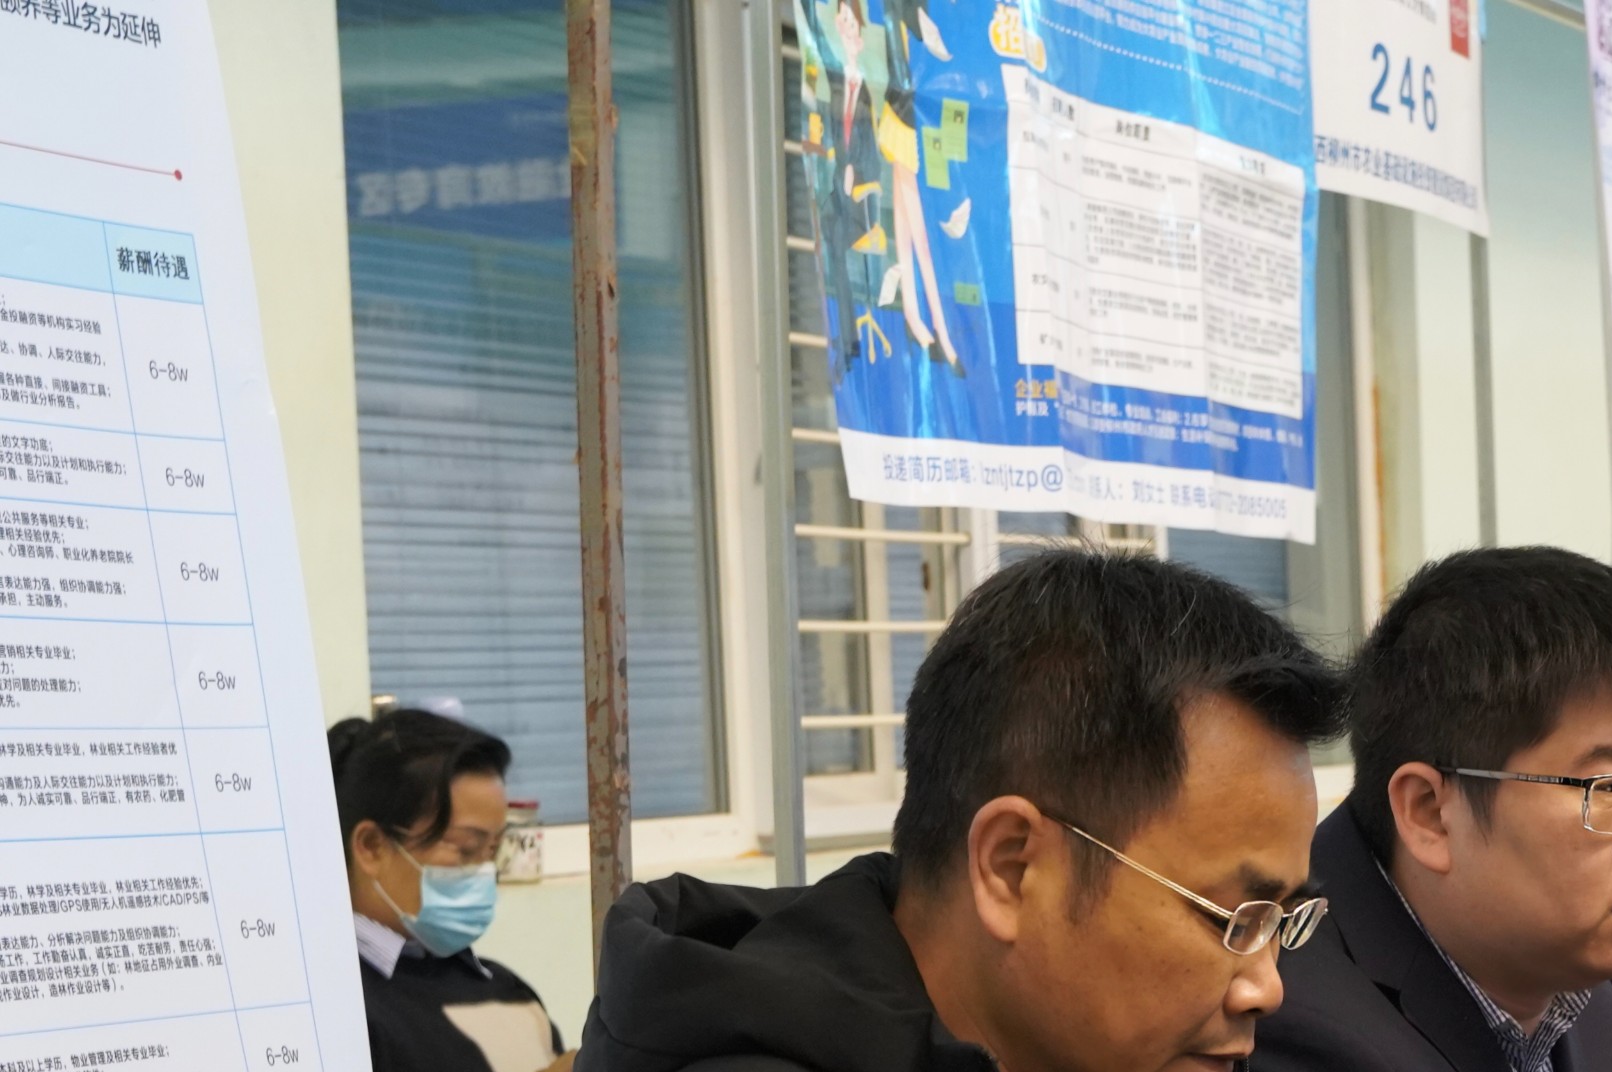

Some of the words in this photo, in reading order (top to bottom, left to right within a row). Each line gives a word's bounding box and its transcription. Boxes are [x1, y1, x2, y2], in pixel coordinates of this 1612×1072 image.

[1370, 43, 1437, 132] 246
[117, 247, 190, 281] 薪酬待遇
[149, 360, 188, 382] 6-8w
[0, 434, 53, 453] 的文字功底；
[166, 467, 205, 488] 6-8w
[0, 511, 90, 530] 公共服务等相关专业；
[180, 561, 219, 582] 6-8w
[0, 678, 82, 694] 对问题的处理能力；
[198, 670, 236, 690] 6-8w
[215, 773, 252, 793] 6-8w
[240, 918, 275, 940] 6-8w
[266, 1045, 299, 1067] 6-8w
